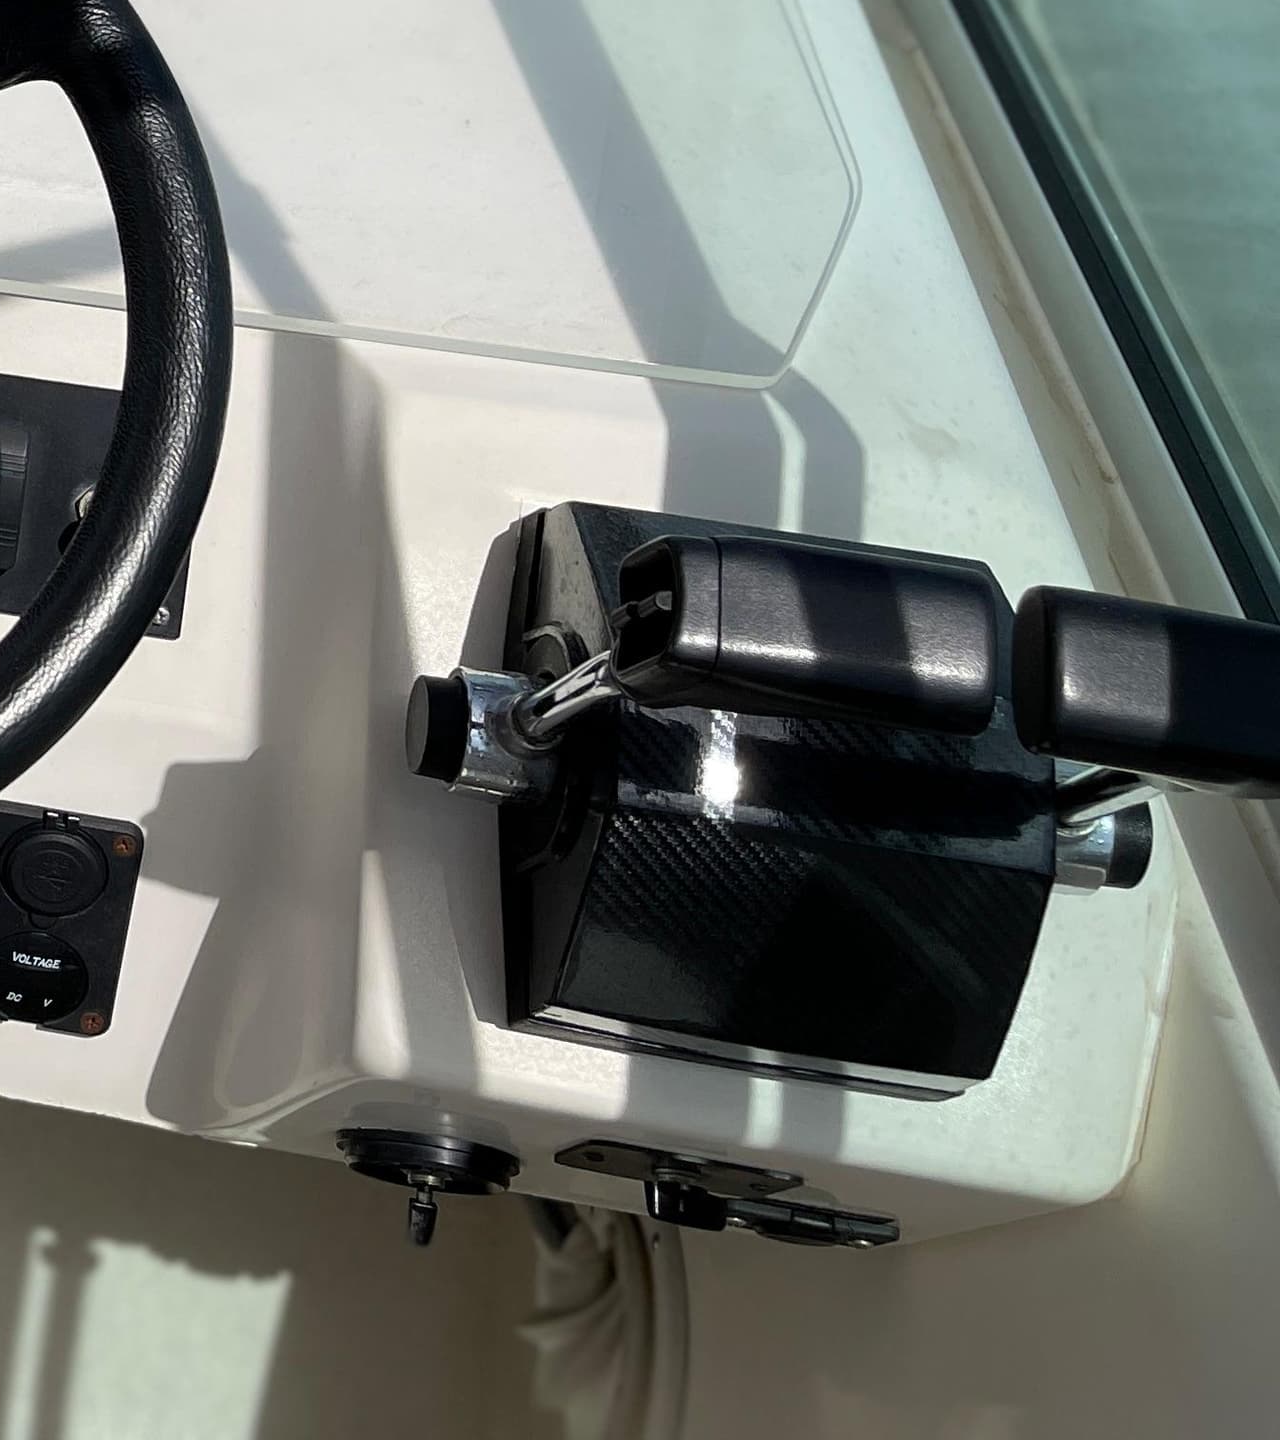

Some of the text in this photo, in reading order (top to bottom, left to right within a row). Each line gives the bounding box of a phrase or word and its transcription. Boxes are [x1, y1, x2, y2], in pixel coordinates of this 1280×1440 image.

[12, 951, 62, 970] VOLTAGE
[5, 991, 53, 1008] DC V
